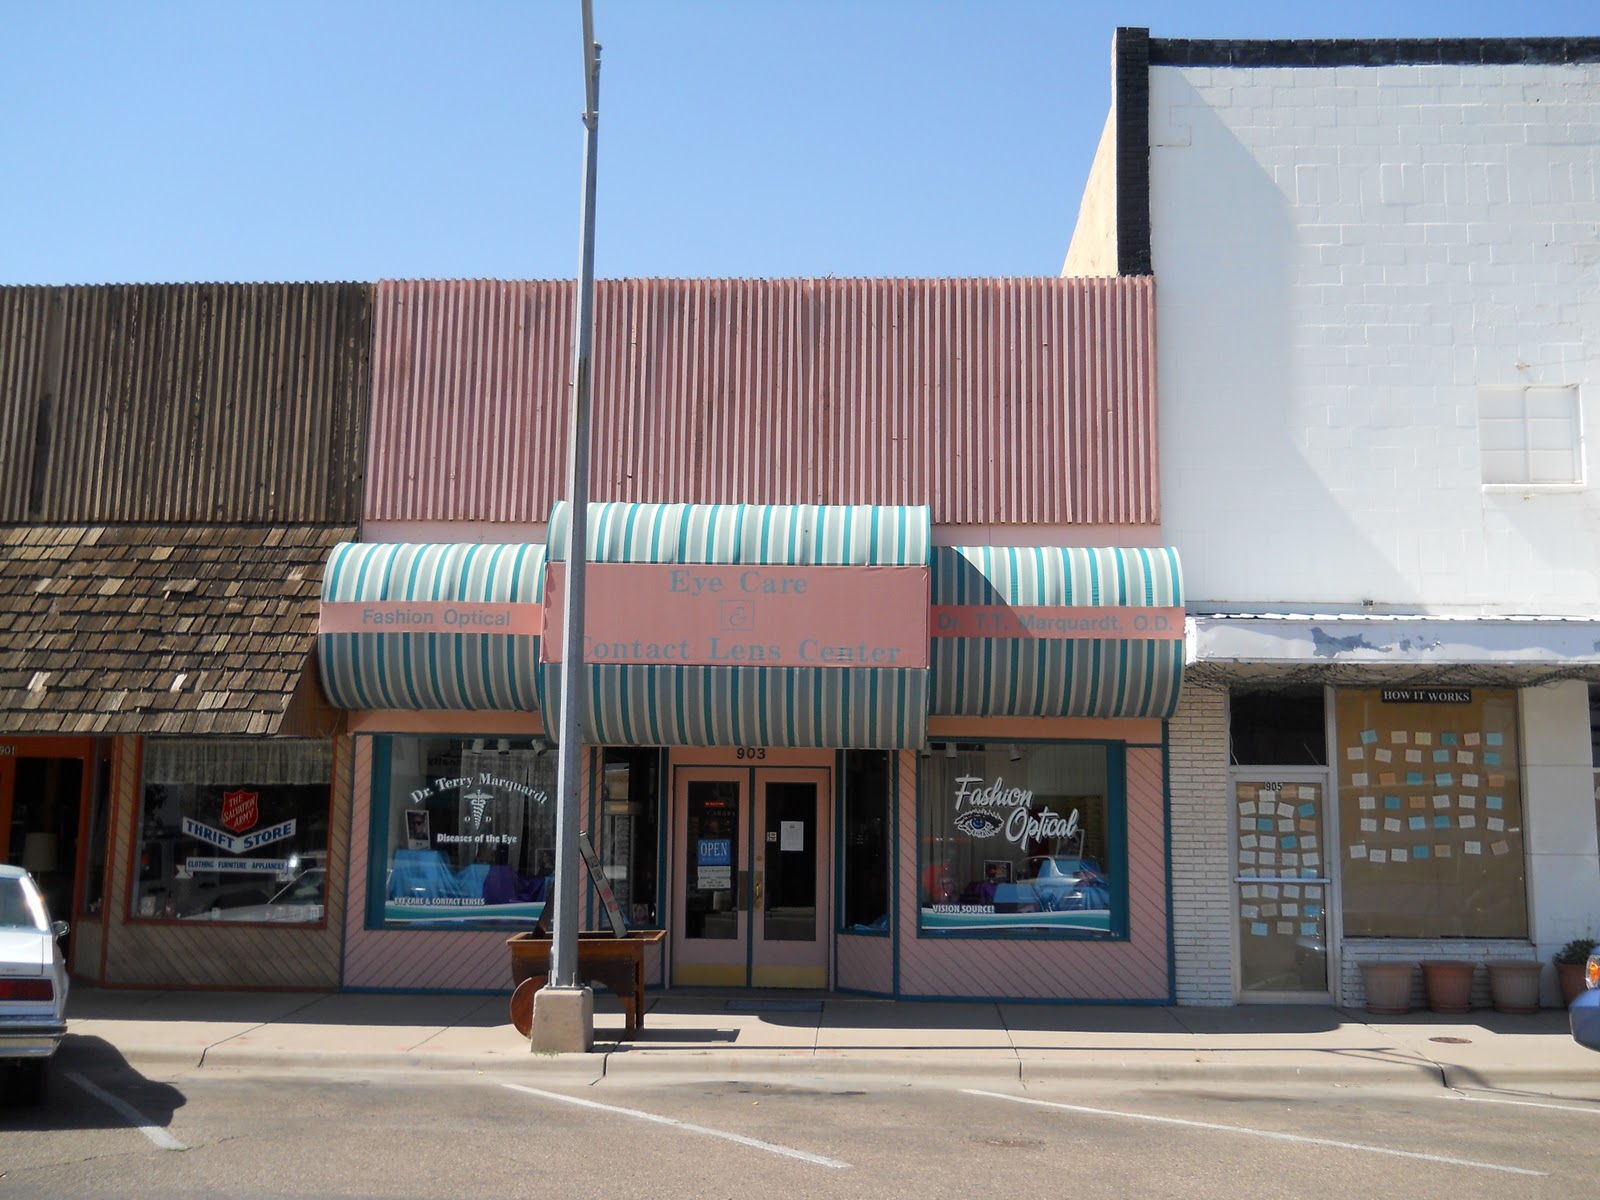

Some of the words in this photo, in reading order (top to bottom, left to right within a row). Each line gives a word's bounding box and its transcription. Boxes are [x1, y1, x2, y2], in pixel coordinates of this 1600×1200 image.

[668, 570, 723, 597] Eye
[740, 571, 809, 595] Care
[362, 608, 434, 625] Fashion
[443, 608, 512, 627] Optical
[937, 613, 966, 630] Dr.
[1018, 614, 1124, 633] Marquardt,
[1132, 614, 1174, 632] O.D.
[708, 637, 781, 662] Lens
[799, 638, 902, 664] Center
[1384, 691, 1410, 700] HOW
[1414, 691, 1425, 700] IT
[1428, 692, 1470, 702] WORKS
[736, 748, 766, 760] 903
[410, 788, 434, 804] Dr.
[435, 777, 474, 792] Terry
[479, 773, 548, 804] Marquardt
[954, 774, 1034, 812] Fashion
[1265, 782, 1283, 791] 905
[228, 794, 244, 808] THE
[233, 807, 254, 828] ARMY
[186, 820, 235, 849] THRIFT
[243, 823, 292, 849] STORE
[1005, 806, 1079, 852] Optical
[437, 833, 473, 843] Diseases
[474, 834, 484, 843] of
[485, 834, 500, 843] the
[501, 834, 518, 845] Eye
[700, 843, 727, 857] OPEN
[188, 861, 214, 869] CLOTHING
[218, 861, 247, 869] FURNITURE
[252, 862, 285, 870] APPLIANCES
[407, 897, 424, 906] CARE
[432, 898, 460, 906] CONTACT
[461, 898, 486, 906] LENSES
[932, 904, 961, 913] VISION
[962, 904, 995, 914] SOURCE!
